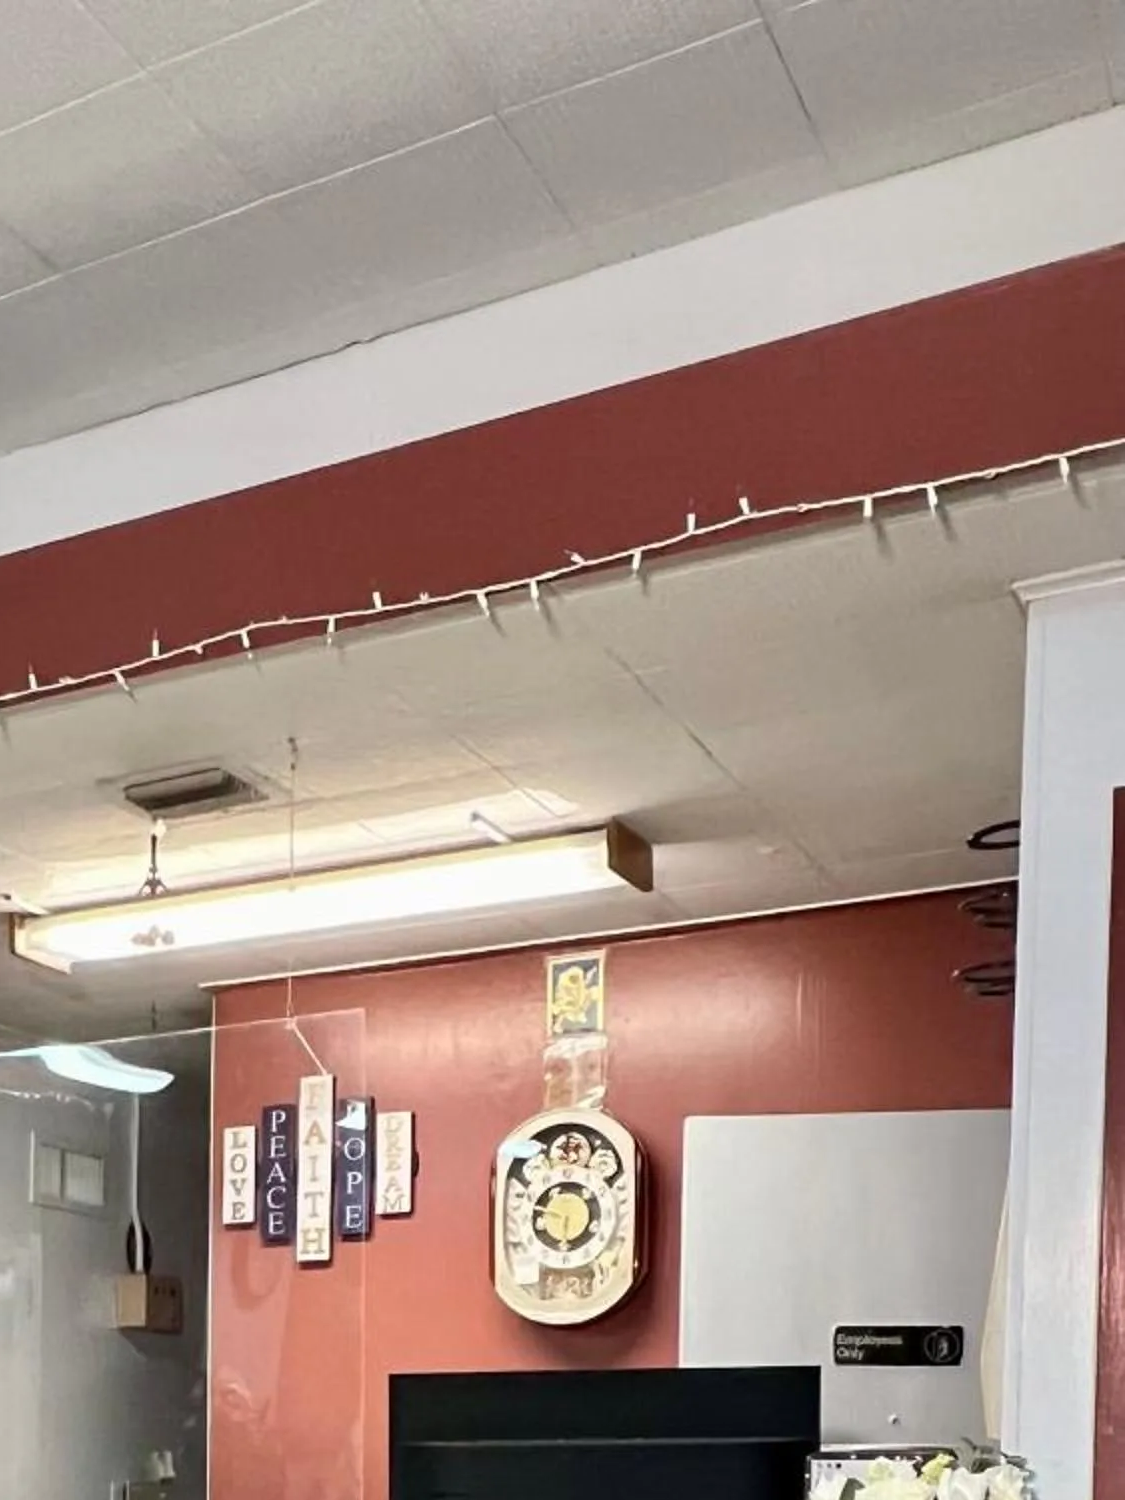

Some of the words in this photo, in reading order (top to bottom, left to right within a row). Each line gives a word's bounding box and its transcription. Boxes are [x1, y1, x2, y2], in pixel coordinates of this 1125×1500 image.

[230, 1131, 248, 1221] LOVE
[266, 1109, 287, 1235] PEACE
[300, 1083, 327, 1255] FAITH
[343, 1102, 366, 1229] OPE
[383, 1116, 404, 1213] DREAM
[836, 1346, 865, 1360] Only
